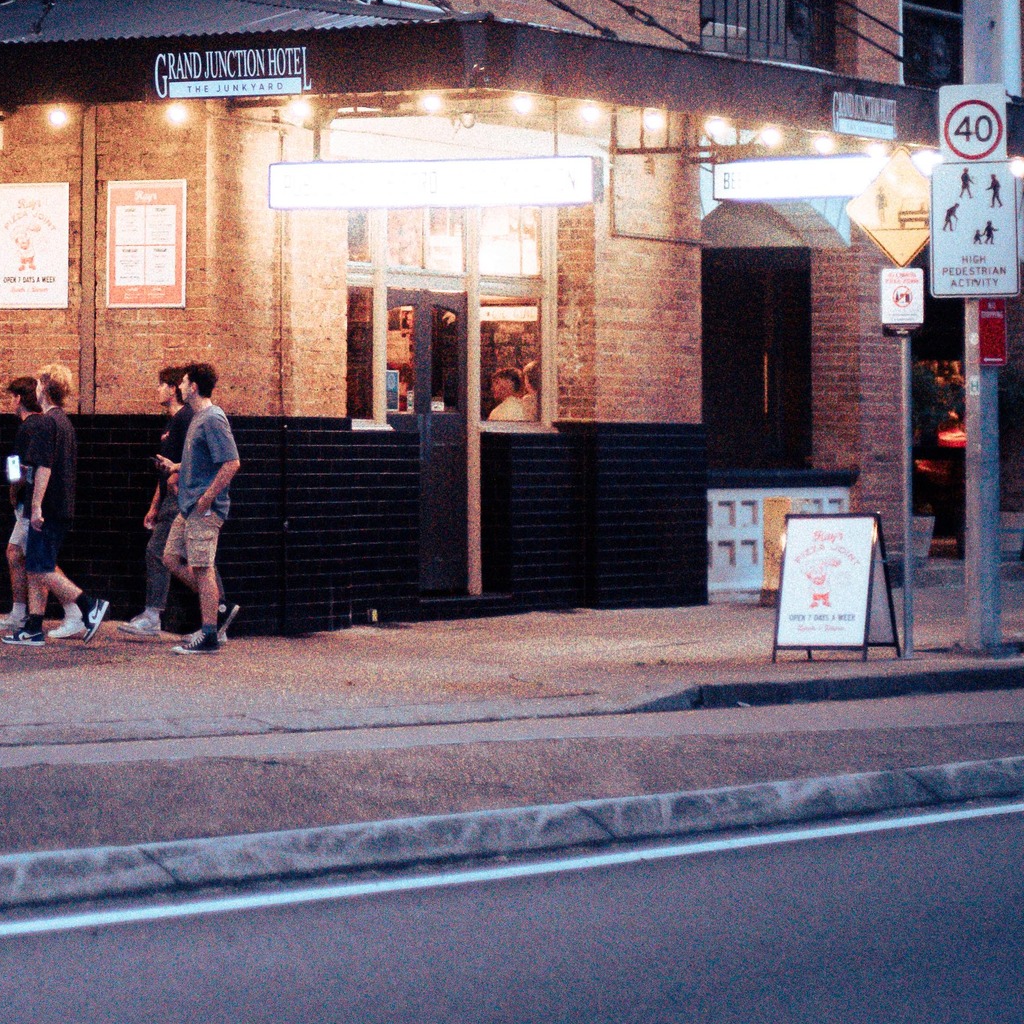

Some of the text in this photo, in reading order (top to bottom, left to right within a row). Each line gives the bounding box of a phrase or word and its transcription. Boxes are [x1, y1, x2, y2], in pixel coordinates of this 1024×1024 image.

[154, 46, 312, 98] GRAND JUNCTION HOTEL
[187, 82, 284, 93] THE JUNKYARD
[953, 115, 993, 142] 40
[32, 212, 57, 231] JOINT
[961, 255, 986, 264] HIGH
[942, 266, 1007, 276] PEDESTRIAN
[951, 277, 999, 287] ACTIVITY
[830, 546, 860, 565] JOINT
[789, 614, 806, 622] OPEN
[814, 614, 829, 622] DAYS
[838, 614, 856, 622] WEEK
